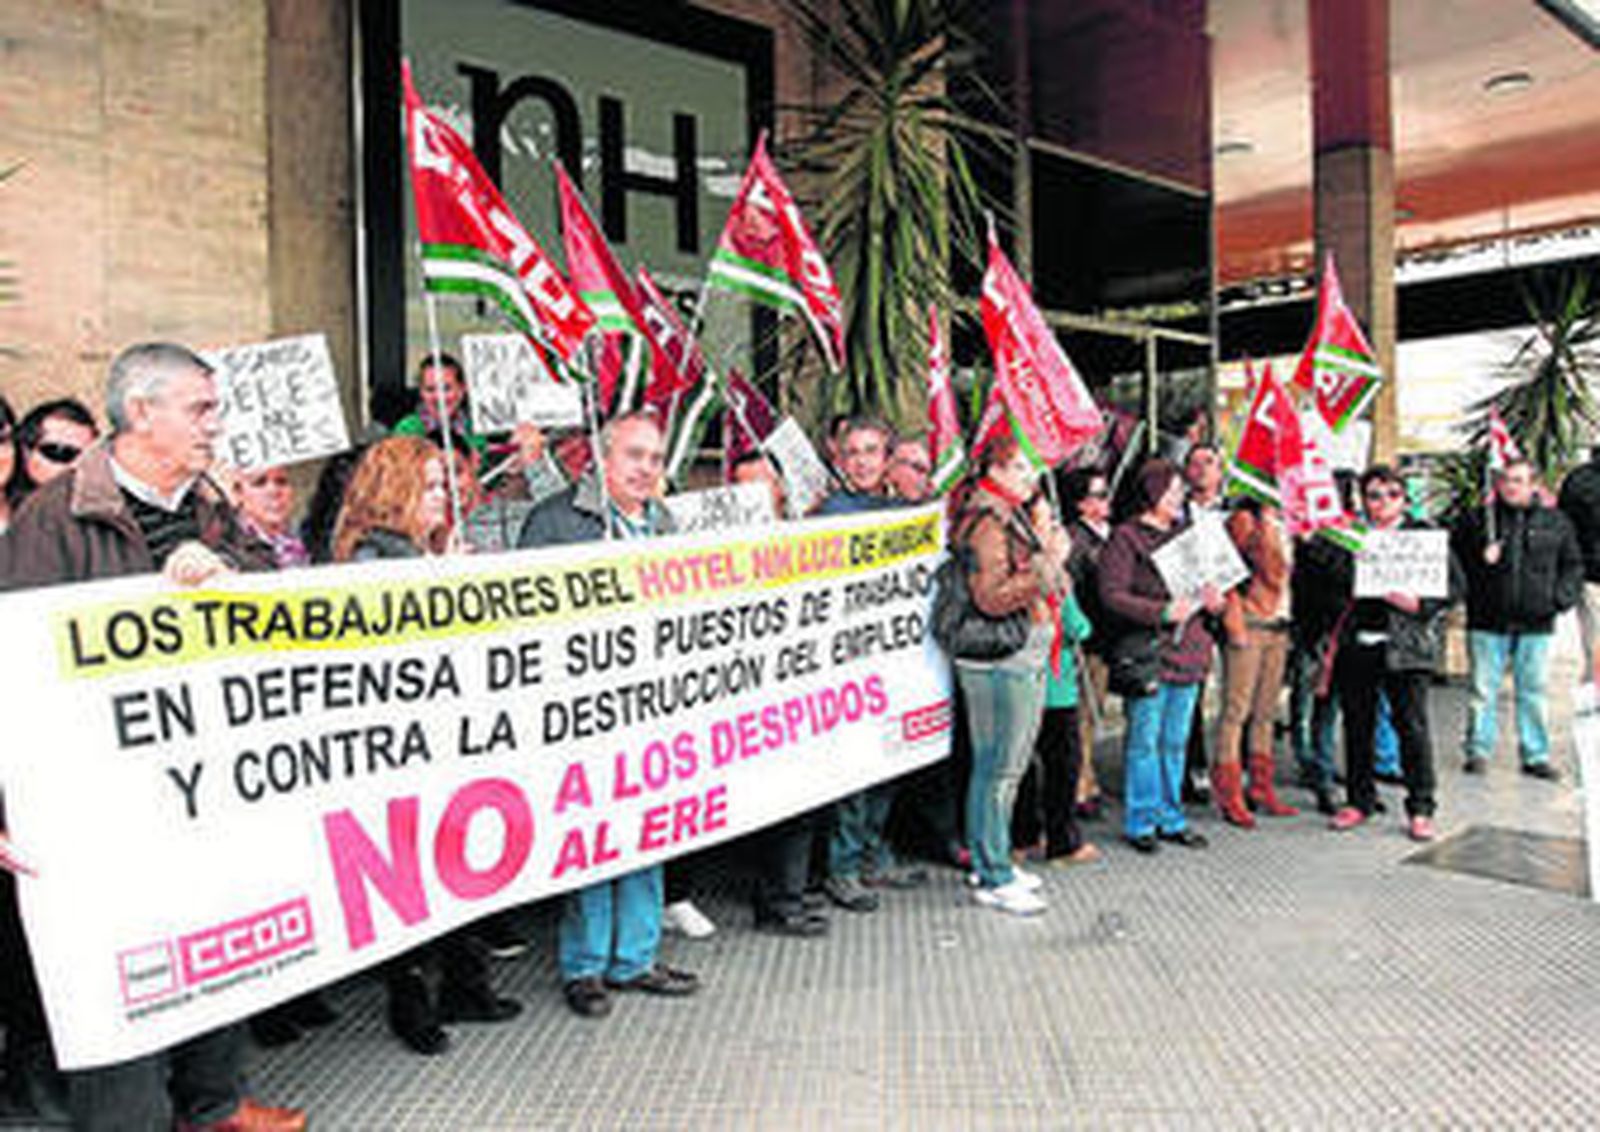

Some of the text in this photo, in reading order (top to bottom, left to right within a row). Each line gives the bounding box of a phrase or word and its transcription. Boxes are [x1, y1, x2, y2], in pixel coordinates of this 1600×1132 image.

[67, 604, 184, 668] LOS
[196, 572, 560, 648] TRABAJADORES
[566, 566, 634, 607] DEL
[638, 546, 745, 600] HOTEL
[797, 534, 844, 575] LUZ
[848, 531, 878, 567] DE
[111, 561, 935, 750] EN DEFENSA DE SUS PUESTOS DE TRABAJO
[166, 609, 924, 820] Y CONTRA LA DESTRUCCIÓN DEL EMPLEO
[321, 673, 890, 952] NO A LOS DESPIDOS
[551, 784, 729, 879] AL ERE
[185, 902, 311, 980] CCOO
